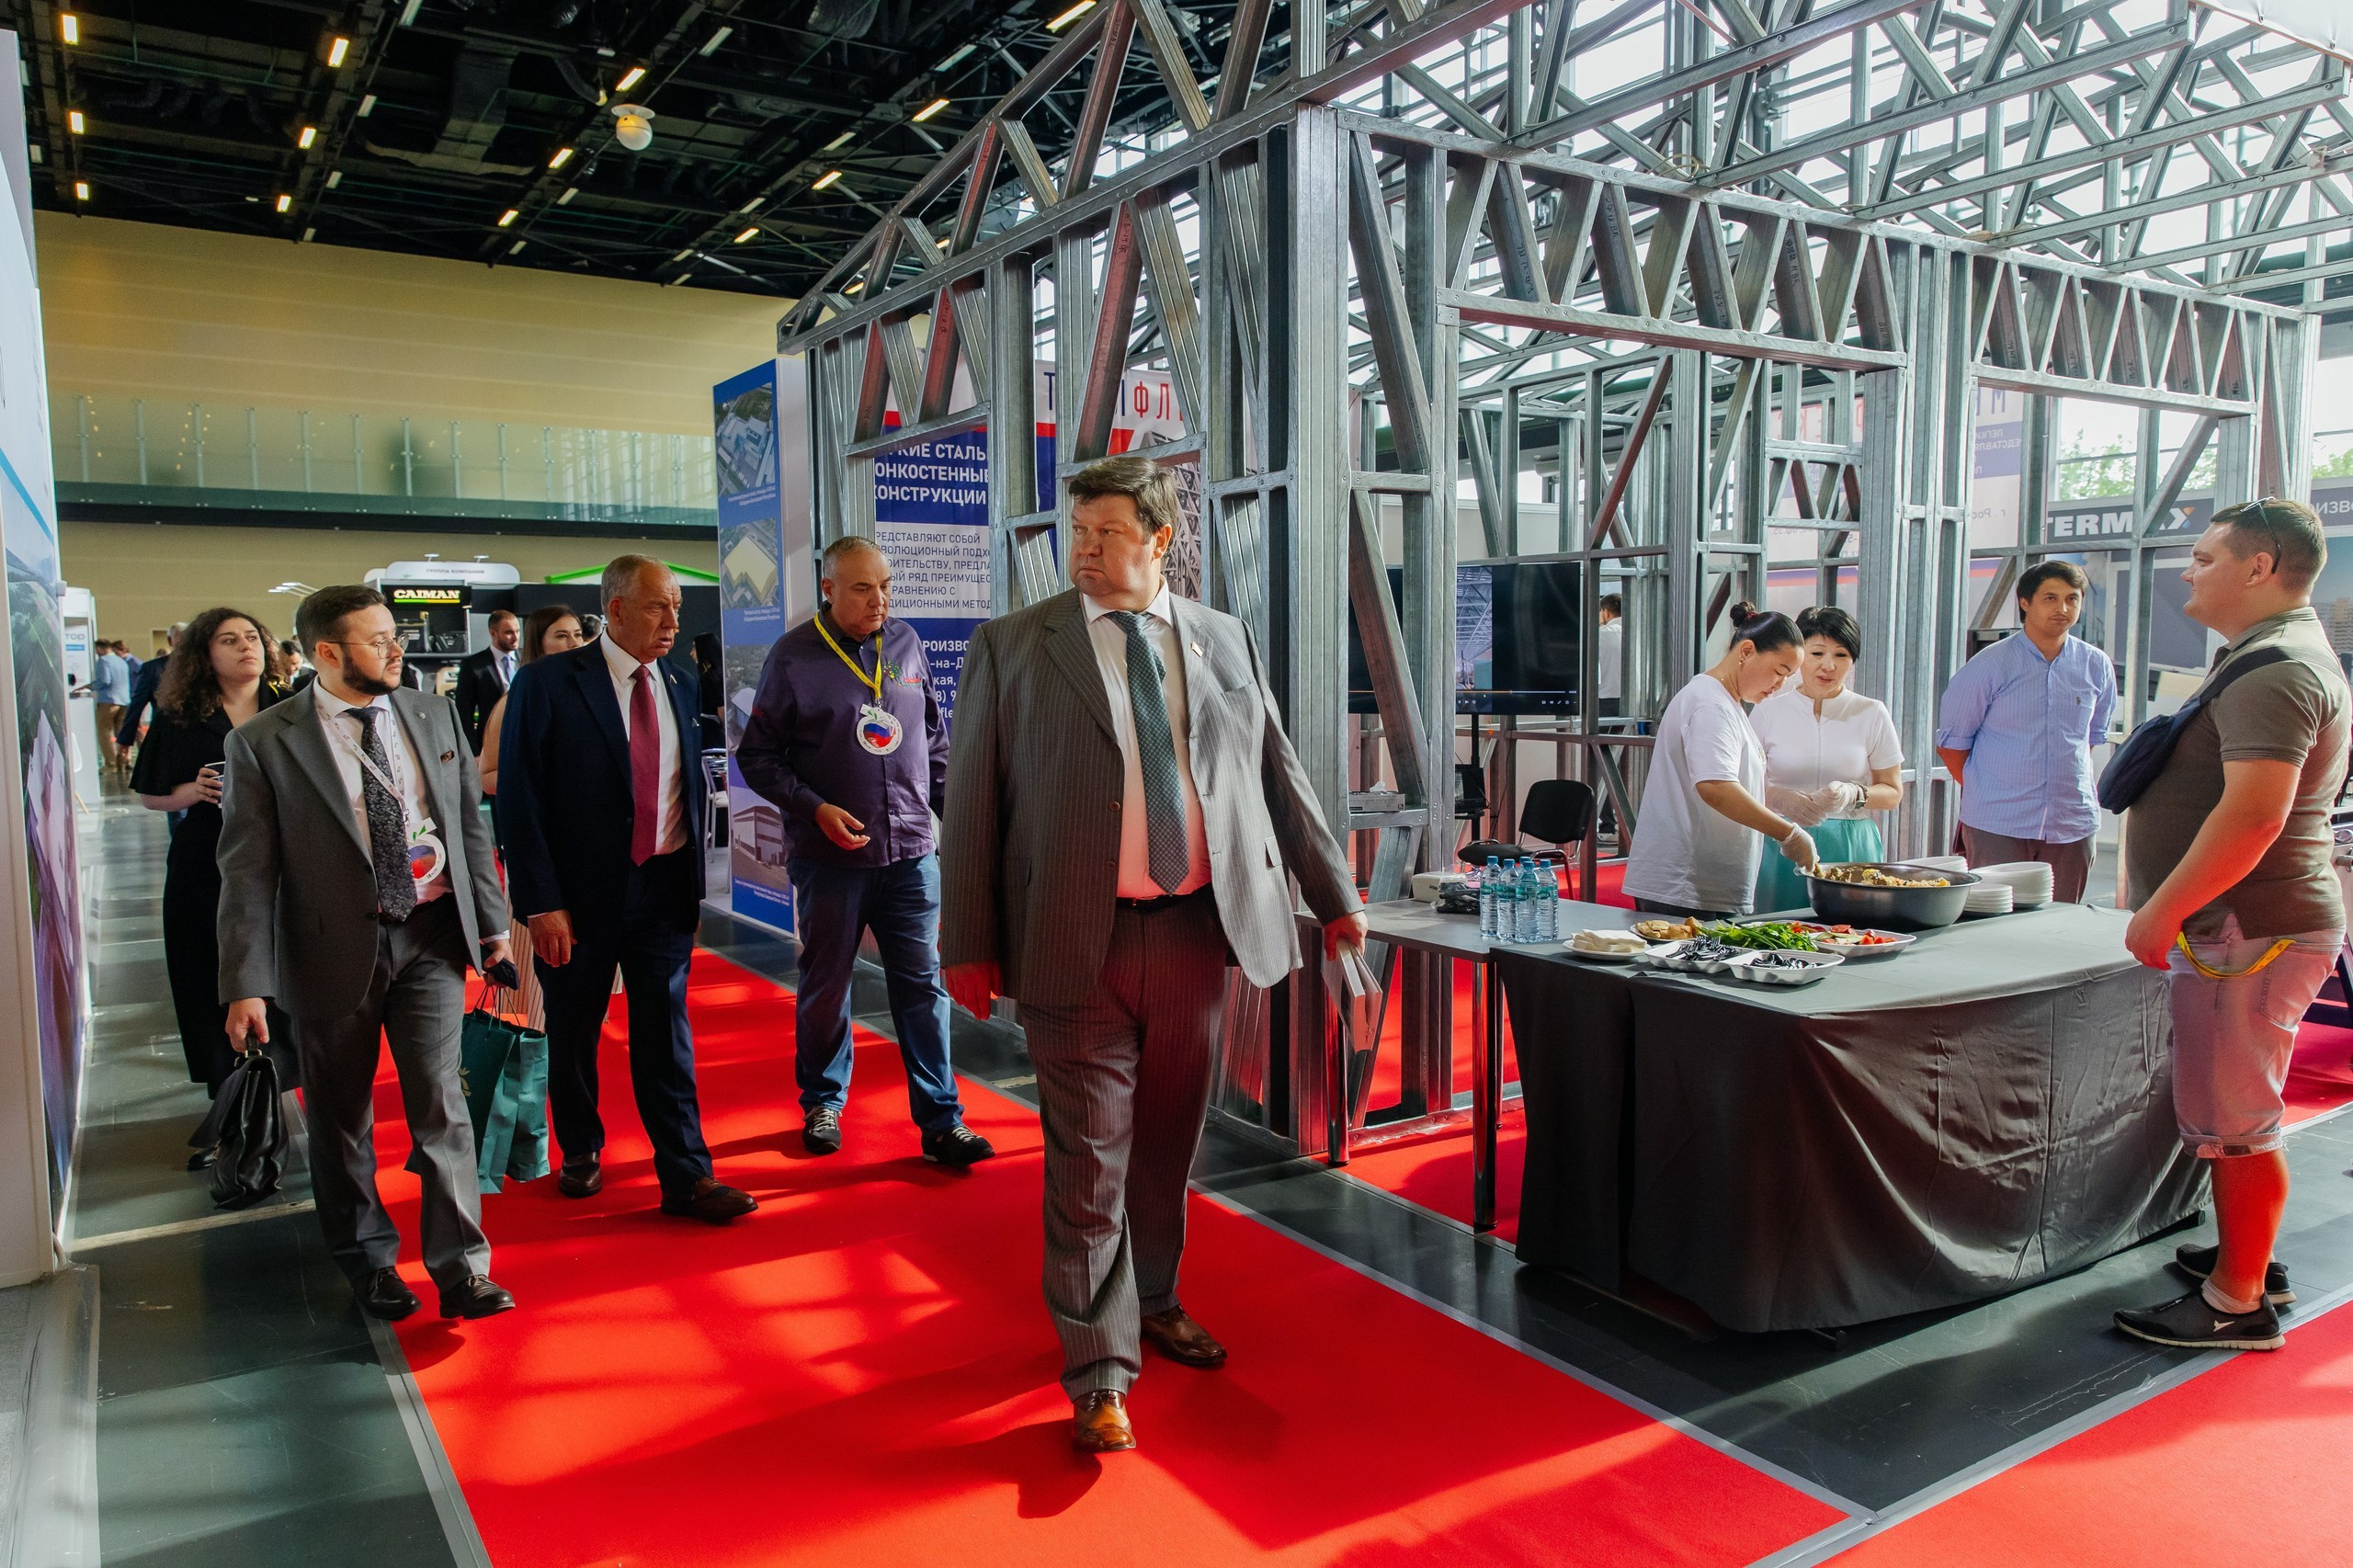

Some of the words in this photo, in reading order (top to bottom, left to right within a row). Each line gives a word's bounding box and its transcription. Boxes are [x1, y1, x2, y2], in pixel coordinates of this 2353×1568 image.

[935, 443, 986, 461] СТАЛЬ
[949, 533, 981, 544] СОБОЙ
[908, 573, 927, 583] РЯД
[393, 589, 460, 599] CAIMAN
[949, 586, 956, 596] С
